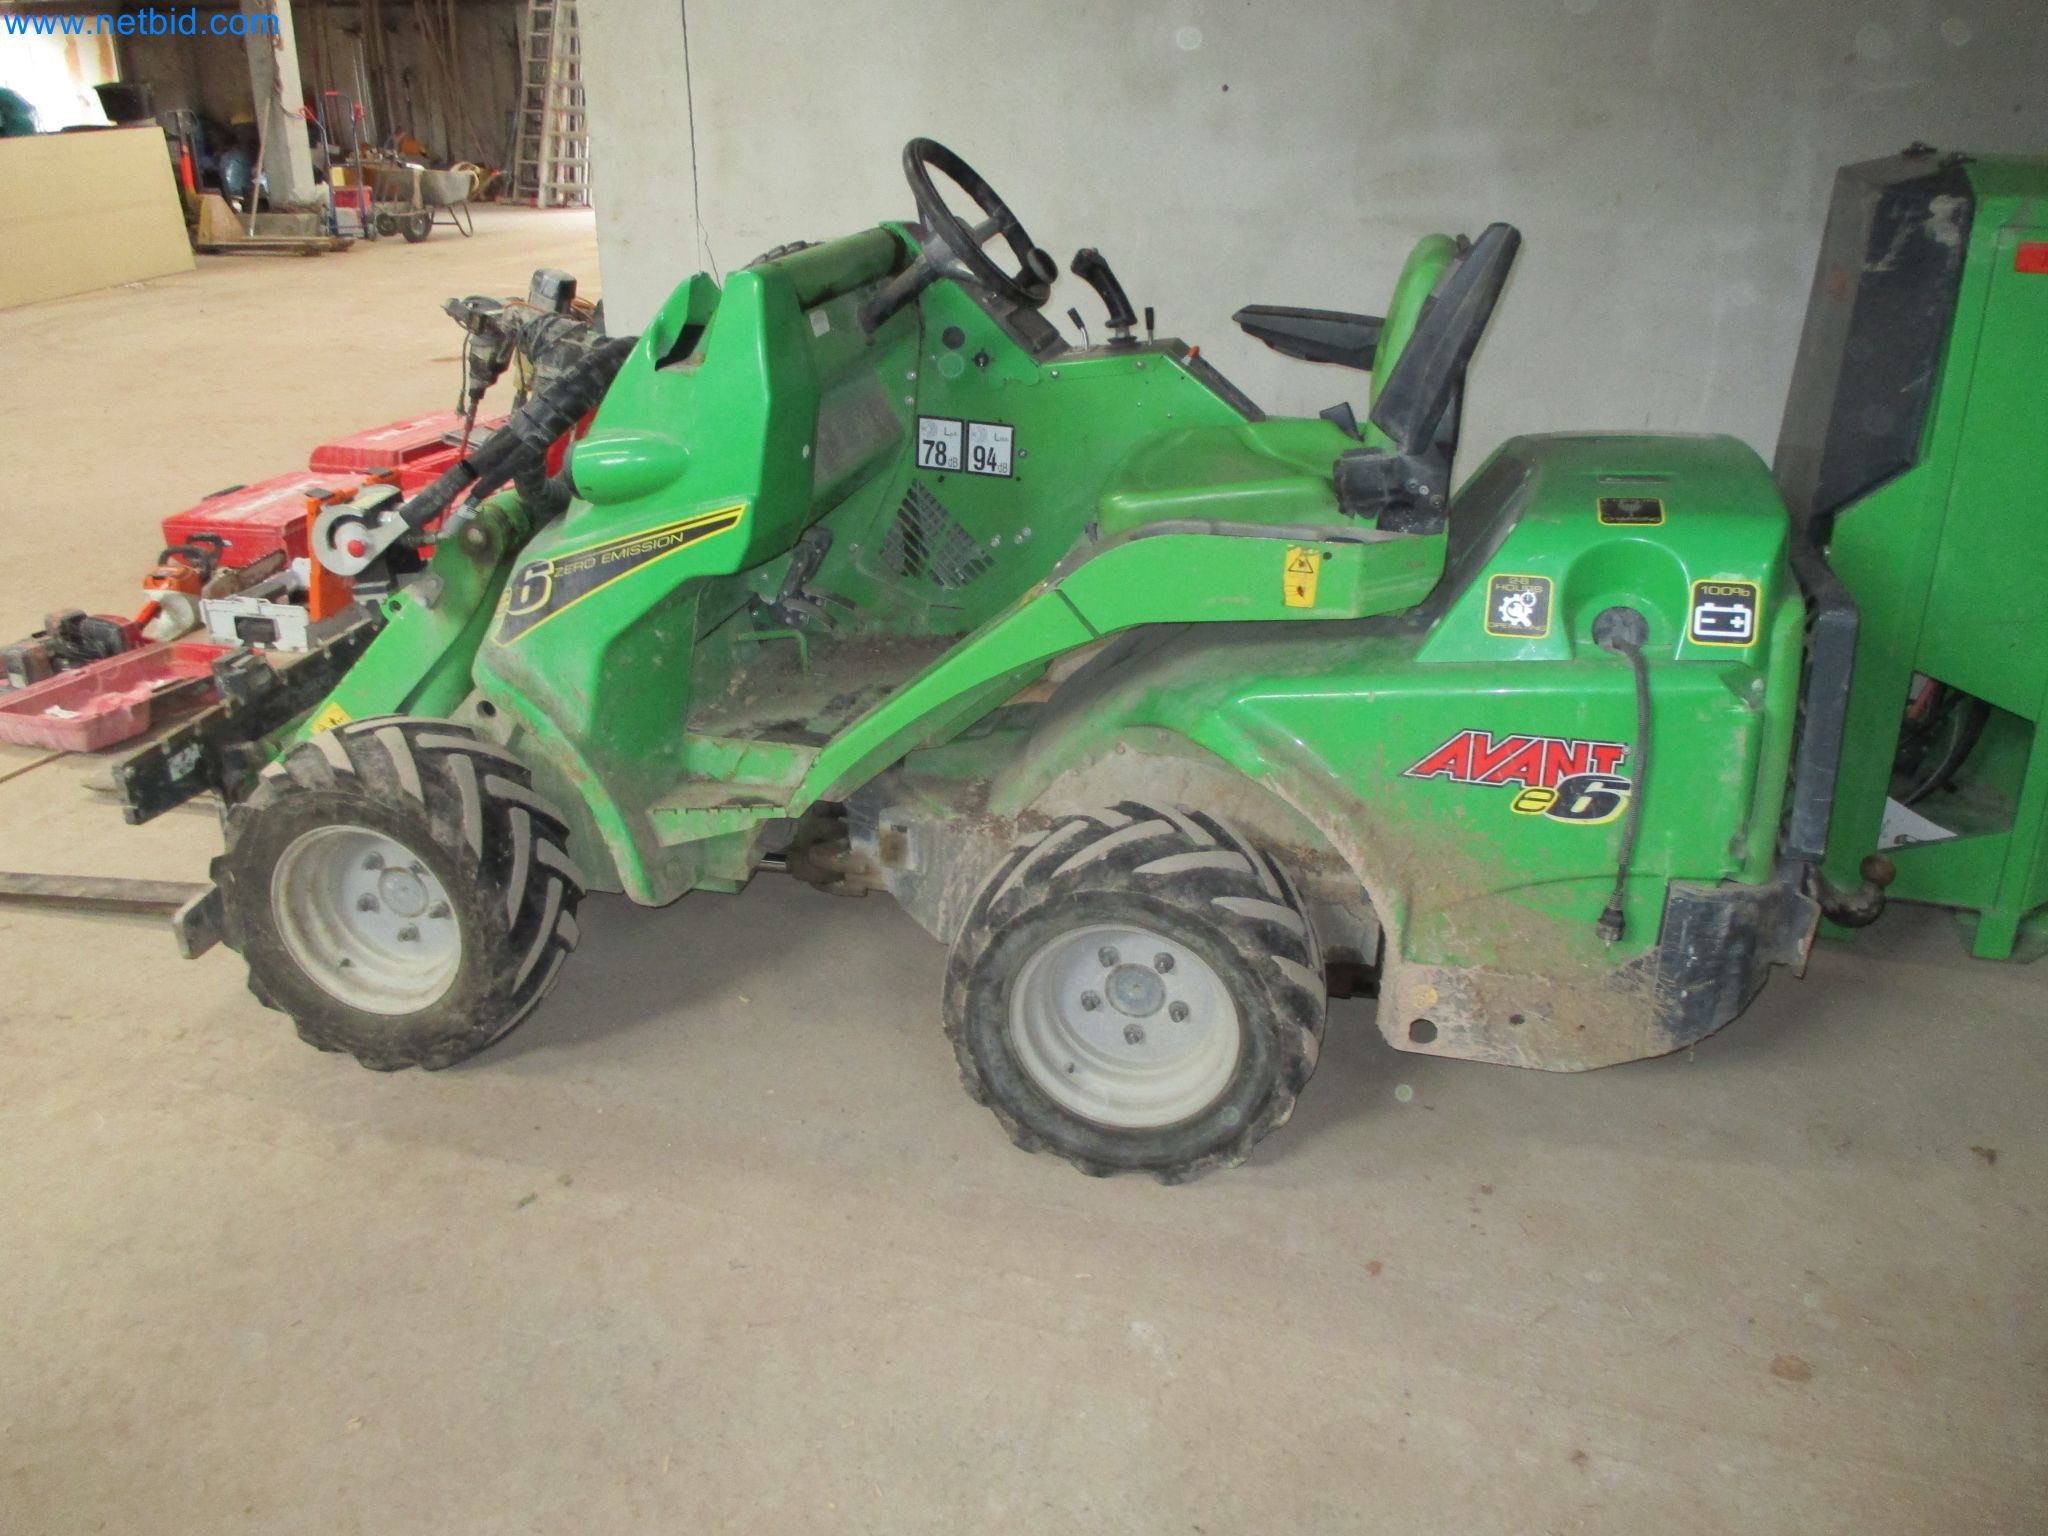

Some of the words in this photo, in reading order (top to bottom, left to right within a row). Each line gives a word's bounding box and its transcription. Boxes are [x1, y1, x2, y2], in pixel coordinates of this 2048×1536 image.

[922, 439, 947, 466] 78
[947, 456, 959, 468] dB
[973, 445, 997, 472] 94
[997, 462, 1009, 474] dB
[553, 557, 596, 578] ZERO
[601, 532, 684, 564] EMISSION
[1495, 584, 1544, 593] HOURS
[1700, 585, 1751, 597] 100%
[1403, 729, 1627, 788] AVANT
